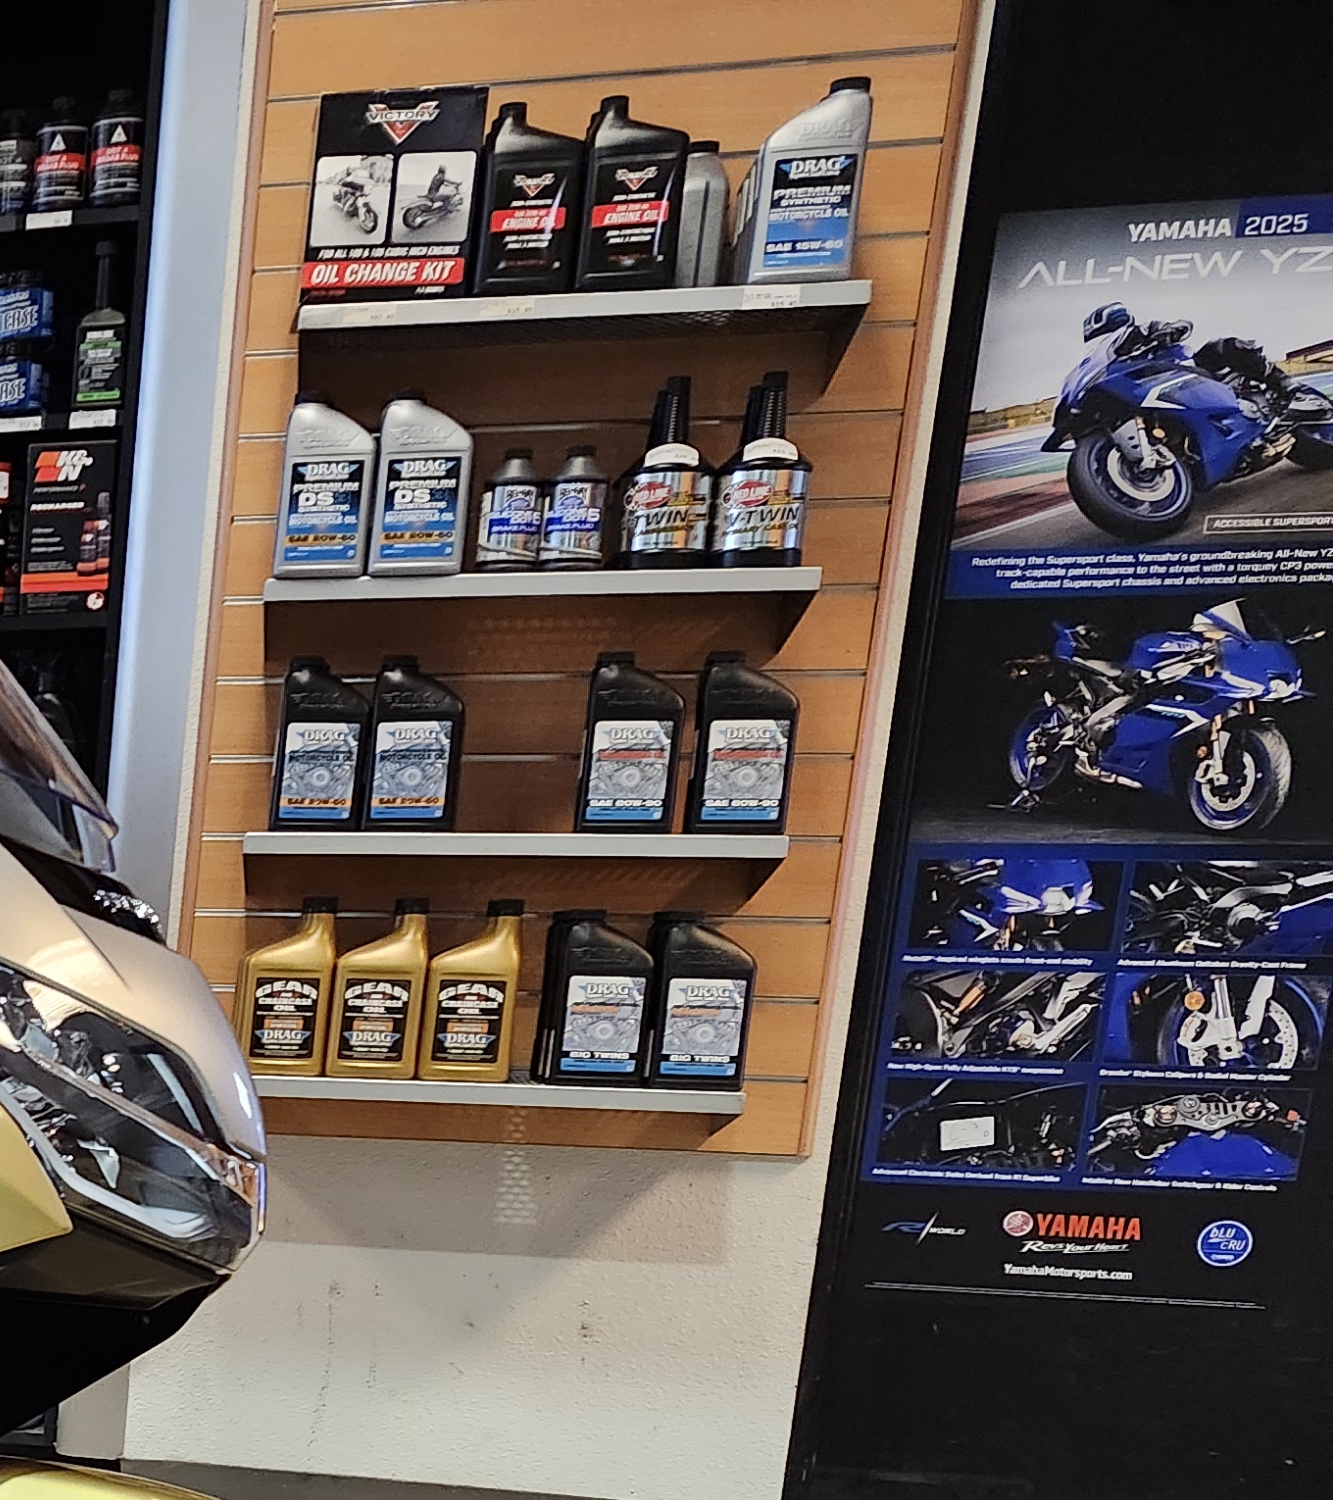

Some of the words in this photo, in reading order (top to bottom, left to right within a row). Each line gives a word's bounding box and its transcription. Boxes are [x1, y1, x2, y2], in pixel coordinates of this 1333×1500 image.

[369, 109, 436, 120] VICTORY
[790, 157, 843, 174] DRAG
[773, 184, 851, 201] PREMIUM
[779, 195, 842, 207] SYNTHETIC
[603, 210, 642, 224] ENGINE
[644, 209, 660, 221] OIL
[769, 209, 832, 222] MOTORCYCLE
[834, 209, 850, 218] OIL
[502, 217, 539, 229] ENGINE
[1128, 217, 1232, 242] YAMAHA
[1244, 213, 1310, 236] 2025
[766, 242, 792, 254] SAE
[311, 263, 340, 285] OIL
[344, 262, 418, 284] CHANGE
[421, 260, 456, 281] KIT
[1019, 249, 1244, 289] ALL-NEW
[307, 462, 350, 475] DRAG
[404, 459, 446, 473] DRAG
[293, 482, 360, 494] PREMIUM
[388, 478, 457, 492] PREMIUM
[728, 506, 801, 527] V-TWIN
[1213, 518, 1273, 529] ACCESSIBLE
[971, 556, 1026, 567] Redefining
[1028, 555, 1045, 565] the
[1046, 554, 1105, 566] Supersport
[1106, 554, 1136, 564] class,
[1138, 552, 1189, 563] Yamaha's
[1189, 549, 1273, 562] groundbreaking
[1275, 549, 1319, 559] All-New
[996, 566, 1066, 577] track-capable
[1067, 565, 1135, 577] performance
[1136, 565, 1149, 574] to
[1150, 564, 1167, 573] the
[1168, 563, 1201, 573] street
[1202, 562, 1226, 572] with
[1236, 562, 1278, 573] torquey
[1280, 561, 1303, 570] CP3
[1010, 579, 1061, 589] dedicated
[1062, 578, 1120, 589] Supersport
[1121, 577, 1162, 587] chassis
[1163, 576, 1184, 586] and
[1185, 575, 1236, 585] advanced
[1238, 573, 1297, 583] electronics
[303, 729, 346, 741] DRAG
[394, 728, 437, 741] DRAG
[611, 727, 655, 740] DRAG
[727, 727, 771, 740] DRAG
[289, 753, 340, 763] MOTORCYCLE
[379, 752, 432, 763] MOTORCYCLE
[255, 980, 318, 1000] GEAR
[345, 982, 410, 1002] GEAR
[438, 983, 505, 1003] GEAR
[586, 983, 629, 995] DRAG
[687, 985, 730, 998] DRAG
[363, 1006, 387, 1014] OIL
[457, 1008, 483, 1016] OIL
[264, 1029, 303, 1041] DRAG
[352, 1031, 392, 1043] DRAG
[446, 1032, 488, 1045] DRAG
[1036, 1213, 1142, 1242] YAMAHA
[1003, 1262, 1133, 1281] YamahaMotorsports.com
